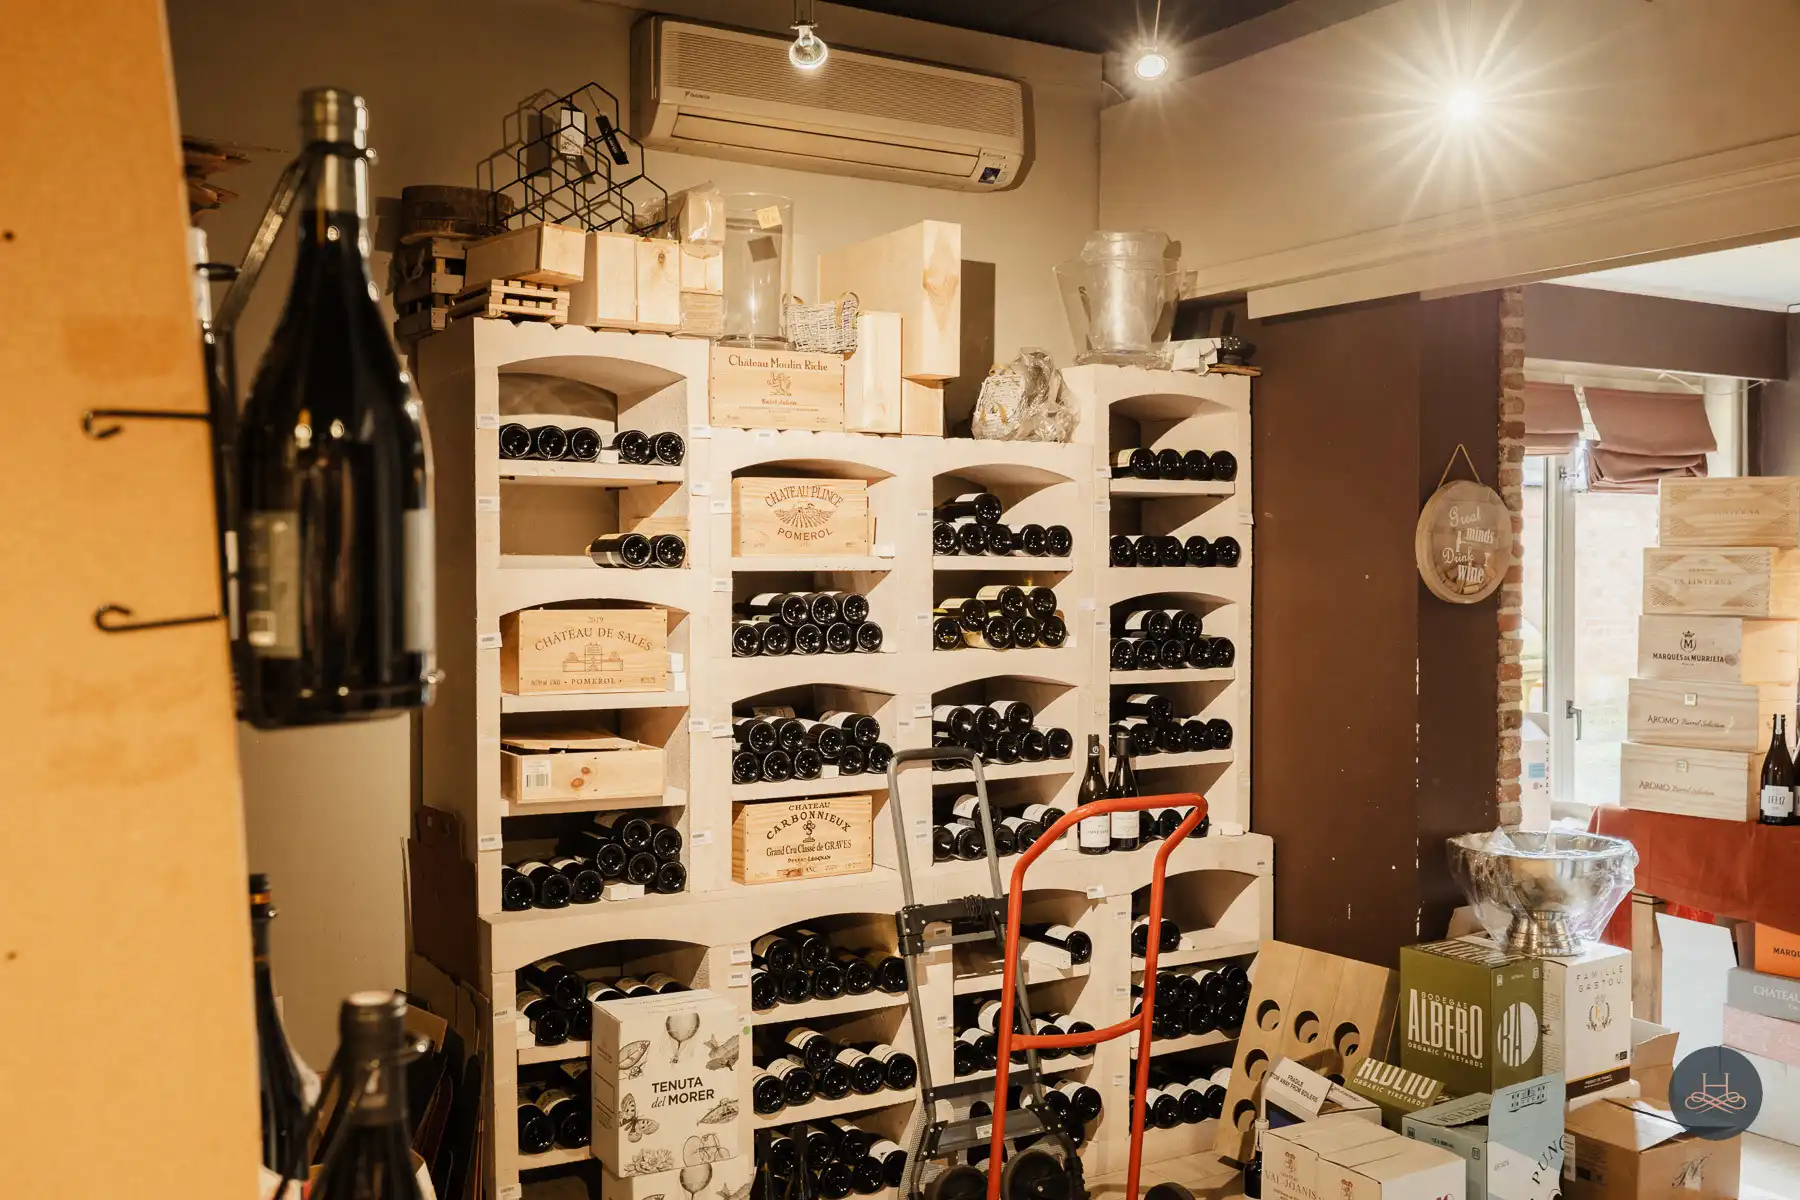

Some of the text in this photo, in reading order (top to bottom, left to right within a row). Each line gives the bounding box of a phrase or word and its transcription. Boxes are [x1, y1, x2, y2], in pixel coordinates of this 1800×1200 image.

[770, 357, 802, 370] Moulin
[804, 360, 828, 371] Riche
[811, 485, 844, 508] PLINCE
[777, 527, 833, 541] POMEROL
[1466, 527, 1495, 544] minds
[1442, 547, 1475, 564] Drink
[1457, 562, 1485, 583] wine
[597, 627, 614, 638] DE
[617, 629, 653, 652] SALES
[1691, 655, 1724, 663] MURRIETA
[571, 677, 616, 685] POMEROL
[1647, 714, 1680, 725] AROMO
[1638, 780, 1671, 792] AROMO
[766, 810, 852, 841] CARBONNIEUX
[766, 847, 786, 857] Grand
[785, 845, 799, 855] Cru
[816, 842, 825, 850] de
[824, 839, 852, 851] GRAVES
[1421, 991, 1468, 1010] BODEGAS
[1407, 988, 1483, 1060] ALBERO
[1407, 1041, 1484, 1069] ORGANIC VINEYARDS
[651, 1076, 704, 1094] TENUTA
[1287, 1074, 1304, 1088] FRAGILE
[1290, 1083, 1302, 1094] FROM
[651, 1089, 715, 1109] del MORER
[1353, 1078, 1426, 1108] ORGANIC VINEYARDS
